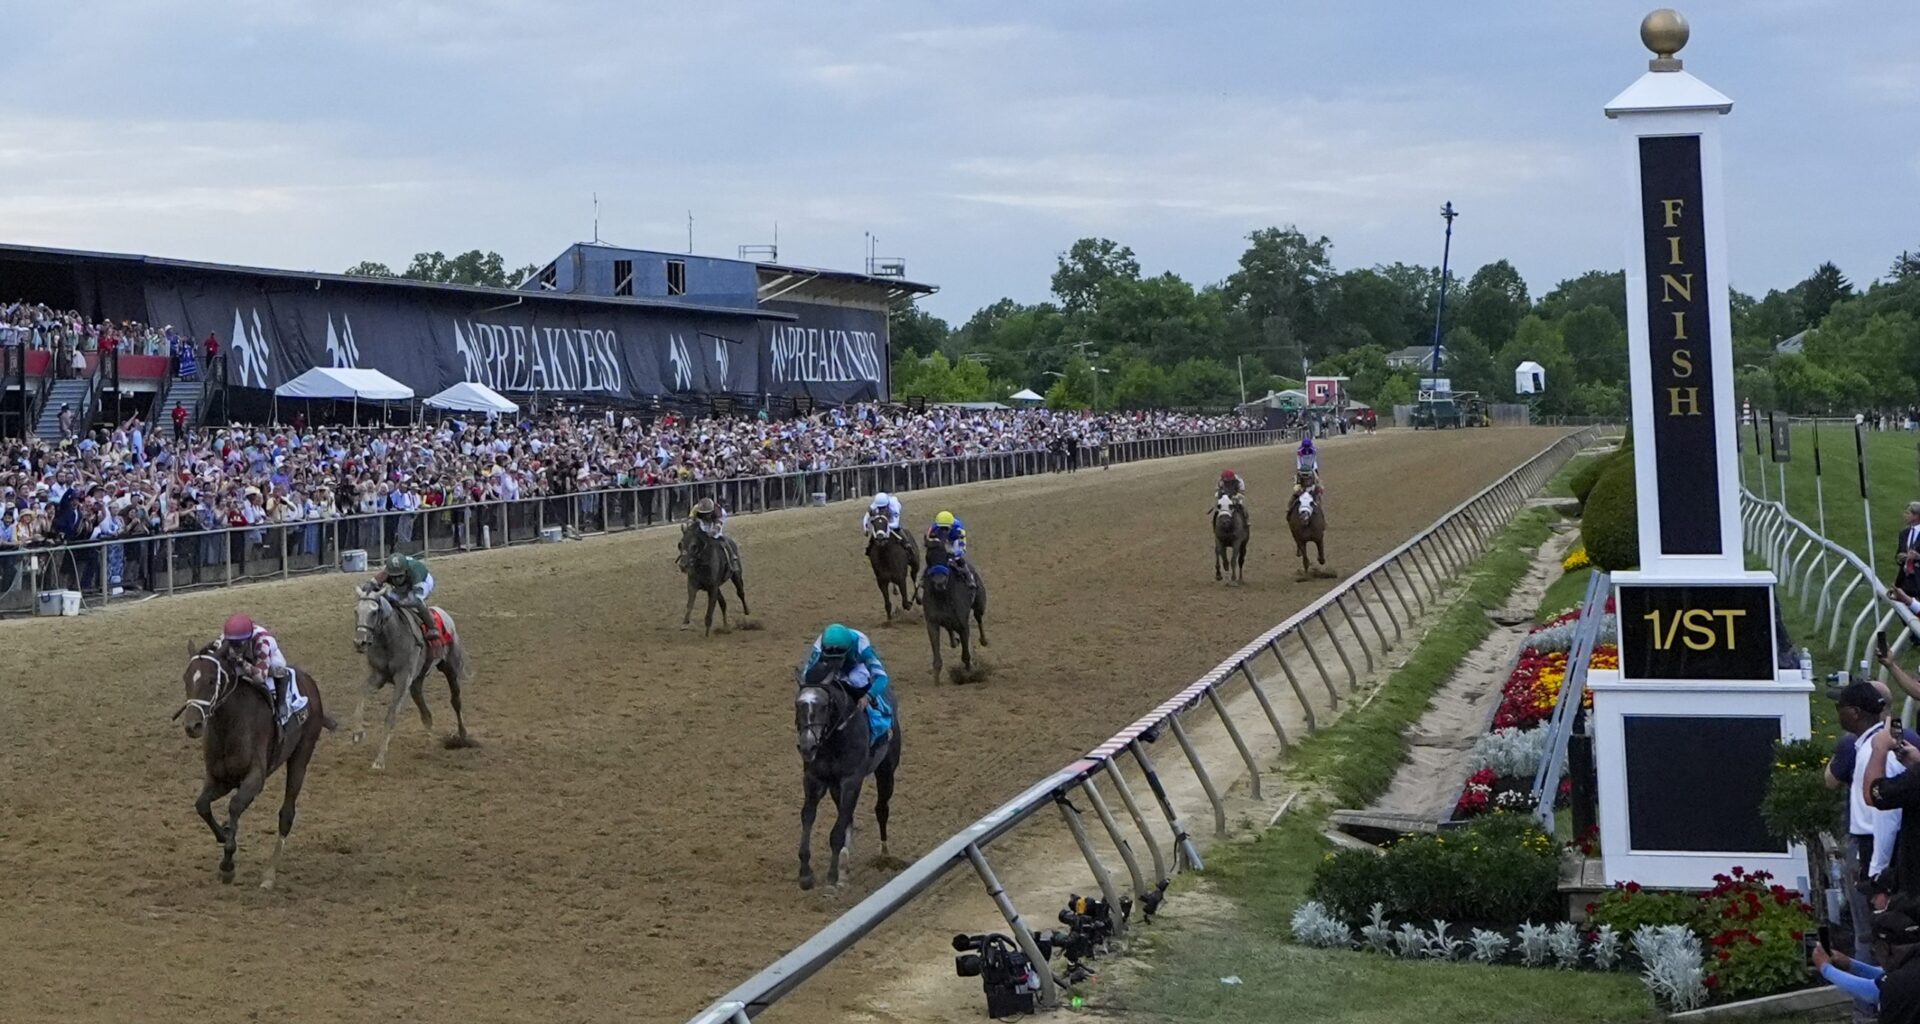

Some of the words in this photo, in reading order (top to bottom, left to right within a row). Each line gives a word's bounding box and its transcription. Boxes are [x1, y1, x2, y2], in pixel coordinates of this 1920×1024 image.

[1660, 199, 1702, 416] FINISH
[476, 323, 621, 392] PREAKNESS
[1643, 609, 1747, 650] 1/ST
